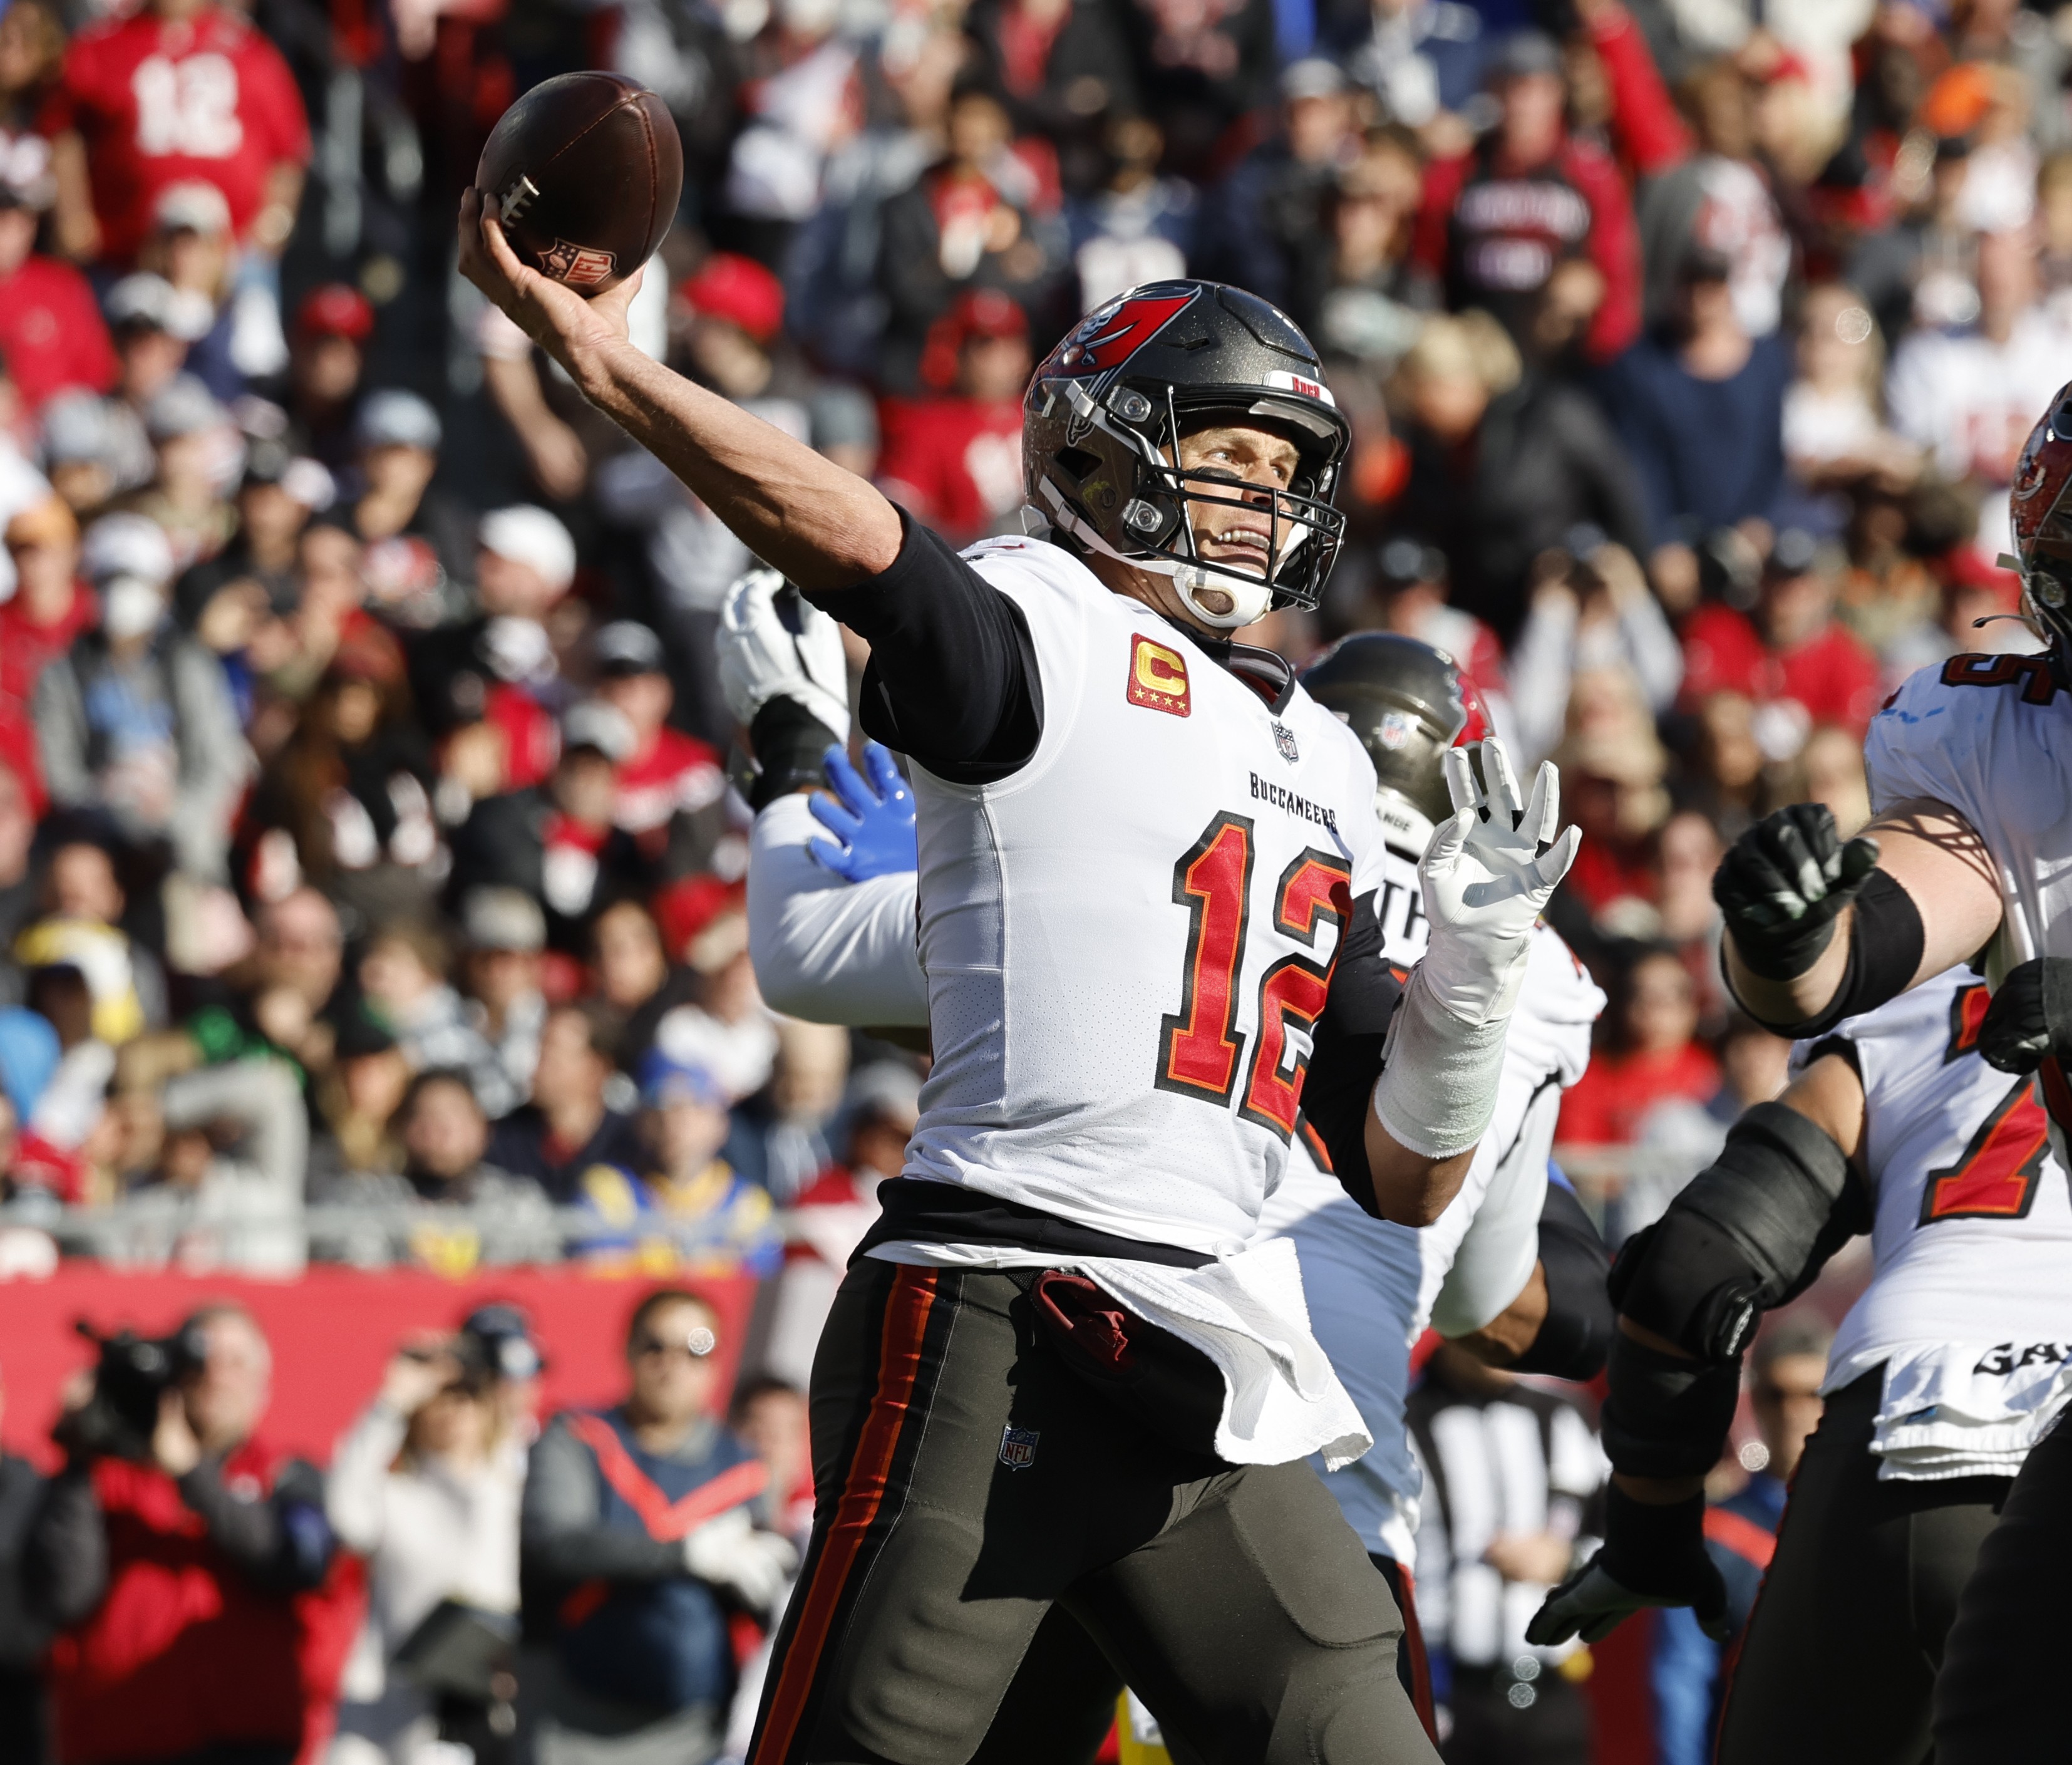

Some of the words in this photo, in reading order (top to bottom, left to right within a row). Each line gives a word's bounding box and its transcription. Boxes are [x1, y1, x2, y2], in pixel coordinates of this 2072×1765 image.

[565, 256, 609, 284] NFL
[1136, 641, 1187, 696] C
[1153, 810, 1358, 1150] 12
[1004, 1442, 1030, 1463] NFL
